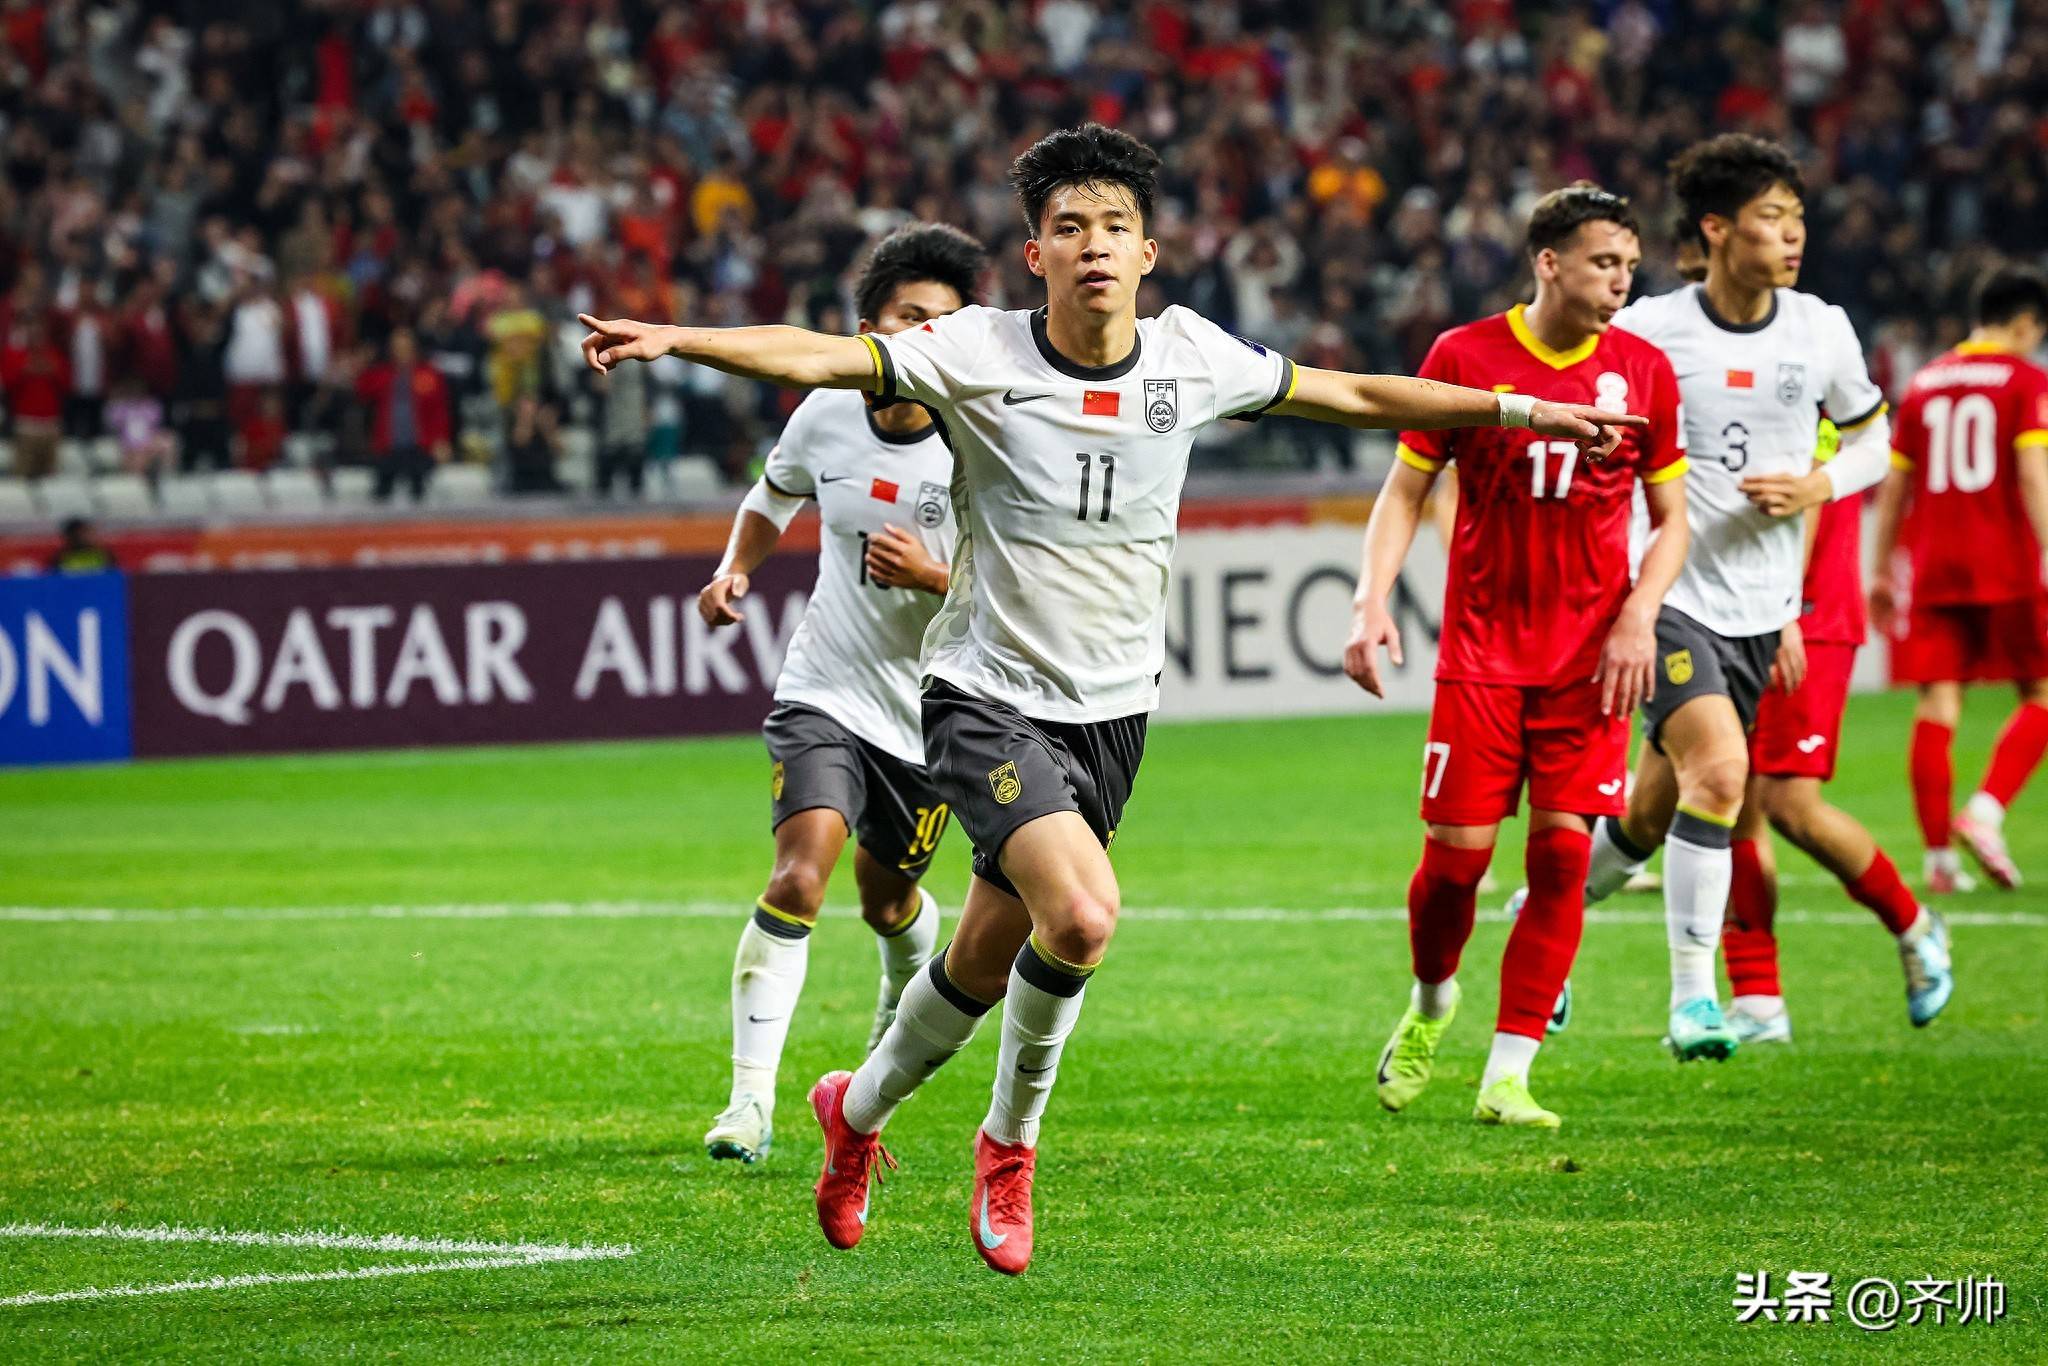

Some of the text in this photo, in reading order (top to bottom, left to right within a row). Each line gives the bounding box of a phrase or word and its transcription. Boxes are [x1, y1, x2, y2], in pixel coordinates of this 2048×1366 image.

[1147, 383, 1173, 392] CFA
[1527, 440, 1579, 499] 17
[1721, 422, 1749, 472] 3
[1922, 393, 1998, 494] 10
[1076, 453, 1114, 522] 11
[858, 531, 892, 590] 1
[0, 608, 103, 726] N
[167, 600, 534, 725] QATAR
[1422, 741, 1451, 799] 7
[909, 802, 948, 855] 10
